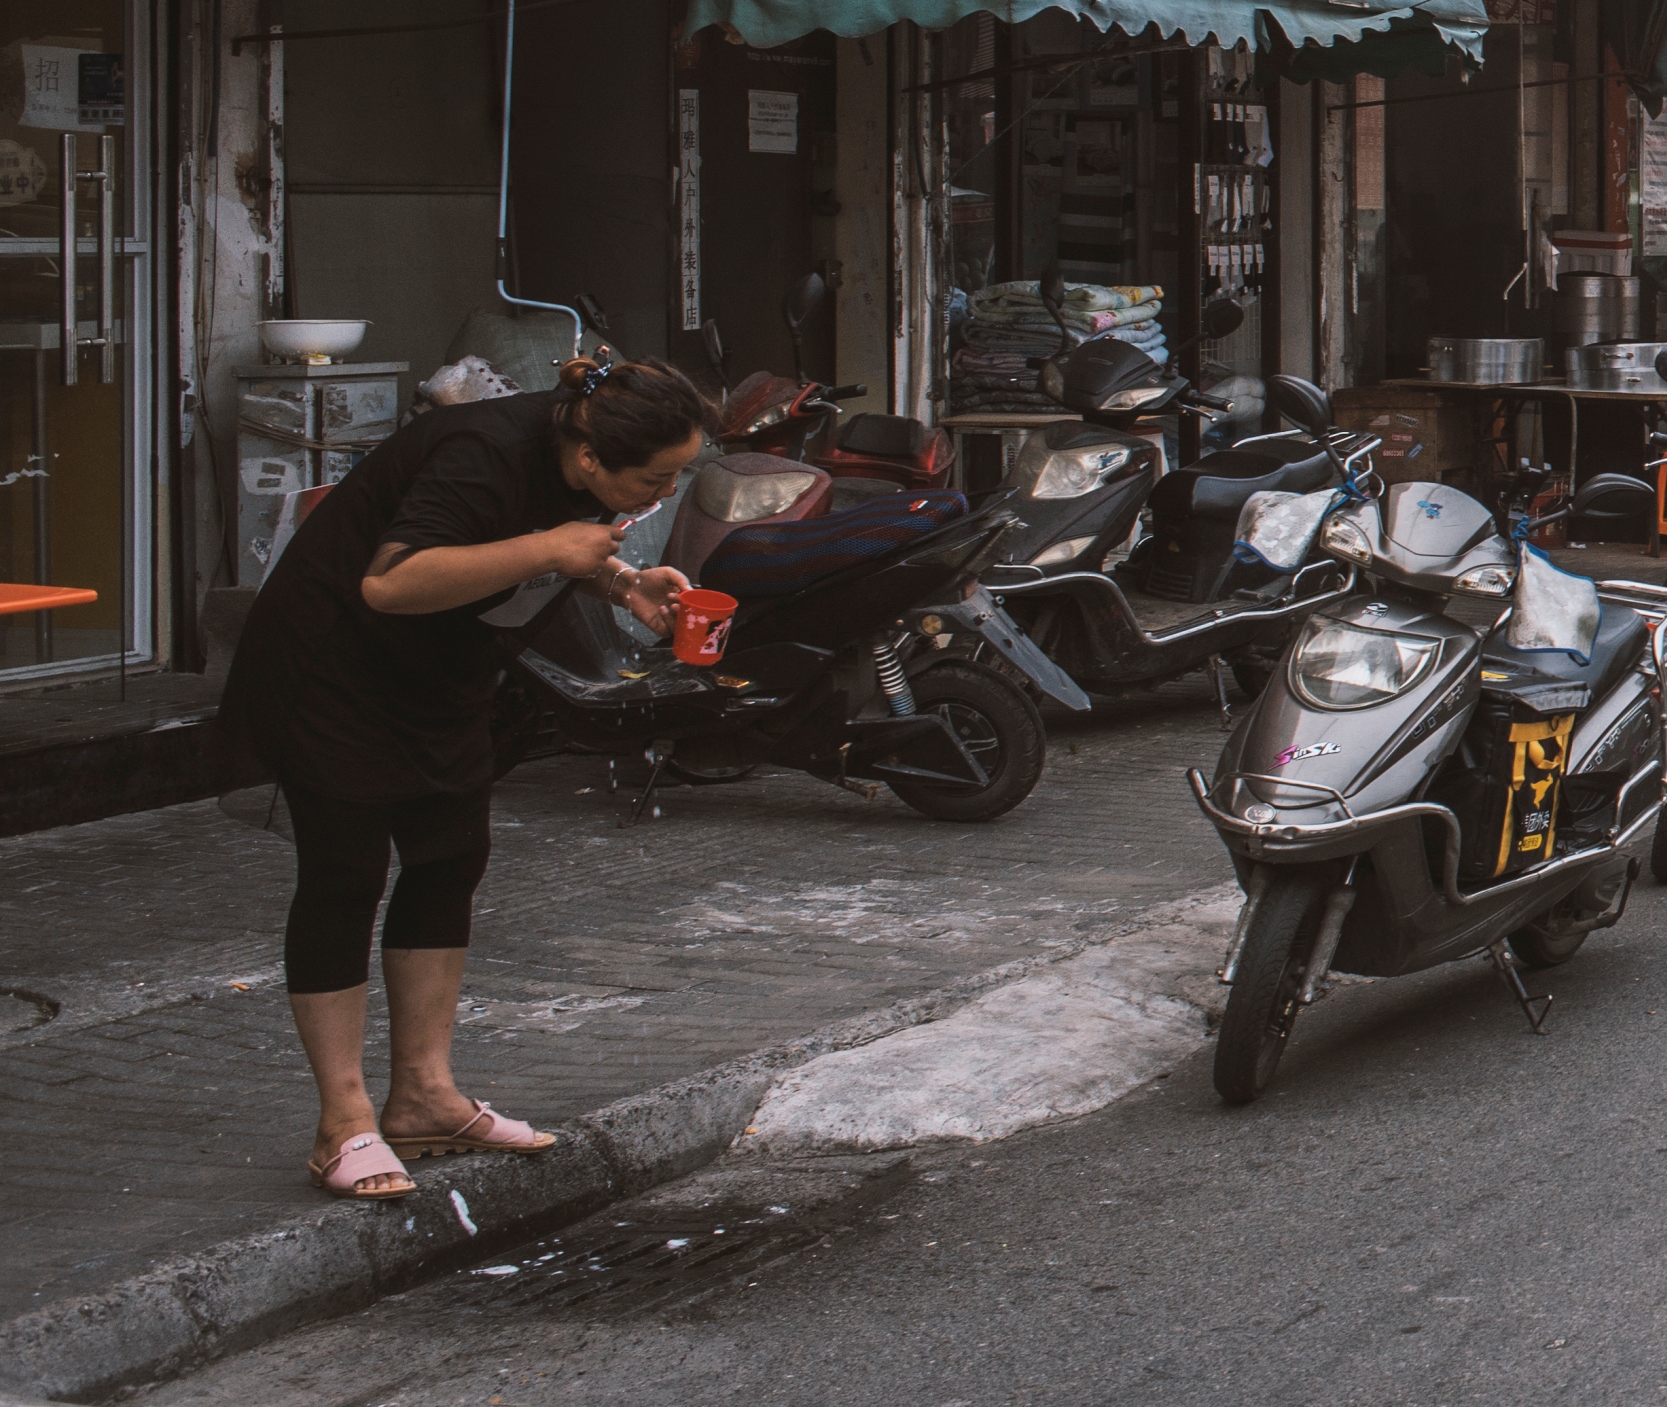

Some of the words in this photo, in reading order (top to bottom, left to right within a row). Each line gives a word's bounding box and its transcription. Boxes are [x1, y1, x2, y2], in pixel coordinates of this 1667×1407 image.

[35, 57, 60, 93] 招
[681, 96, 699, 329] 玛雅人户外装备店
